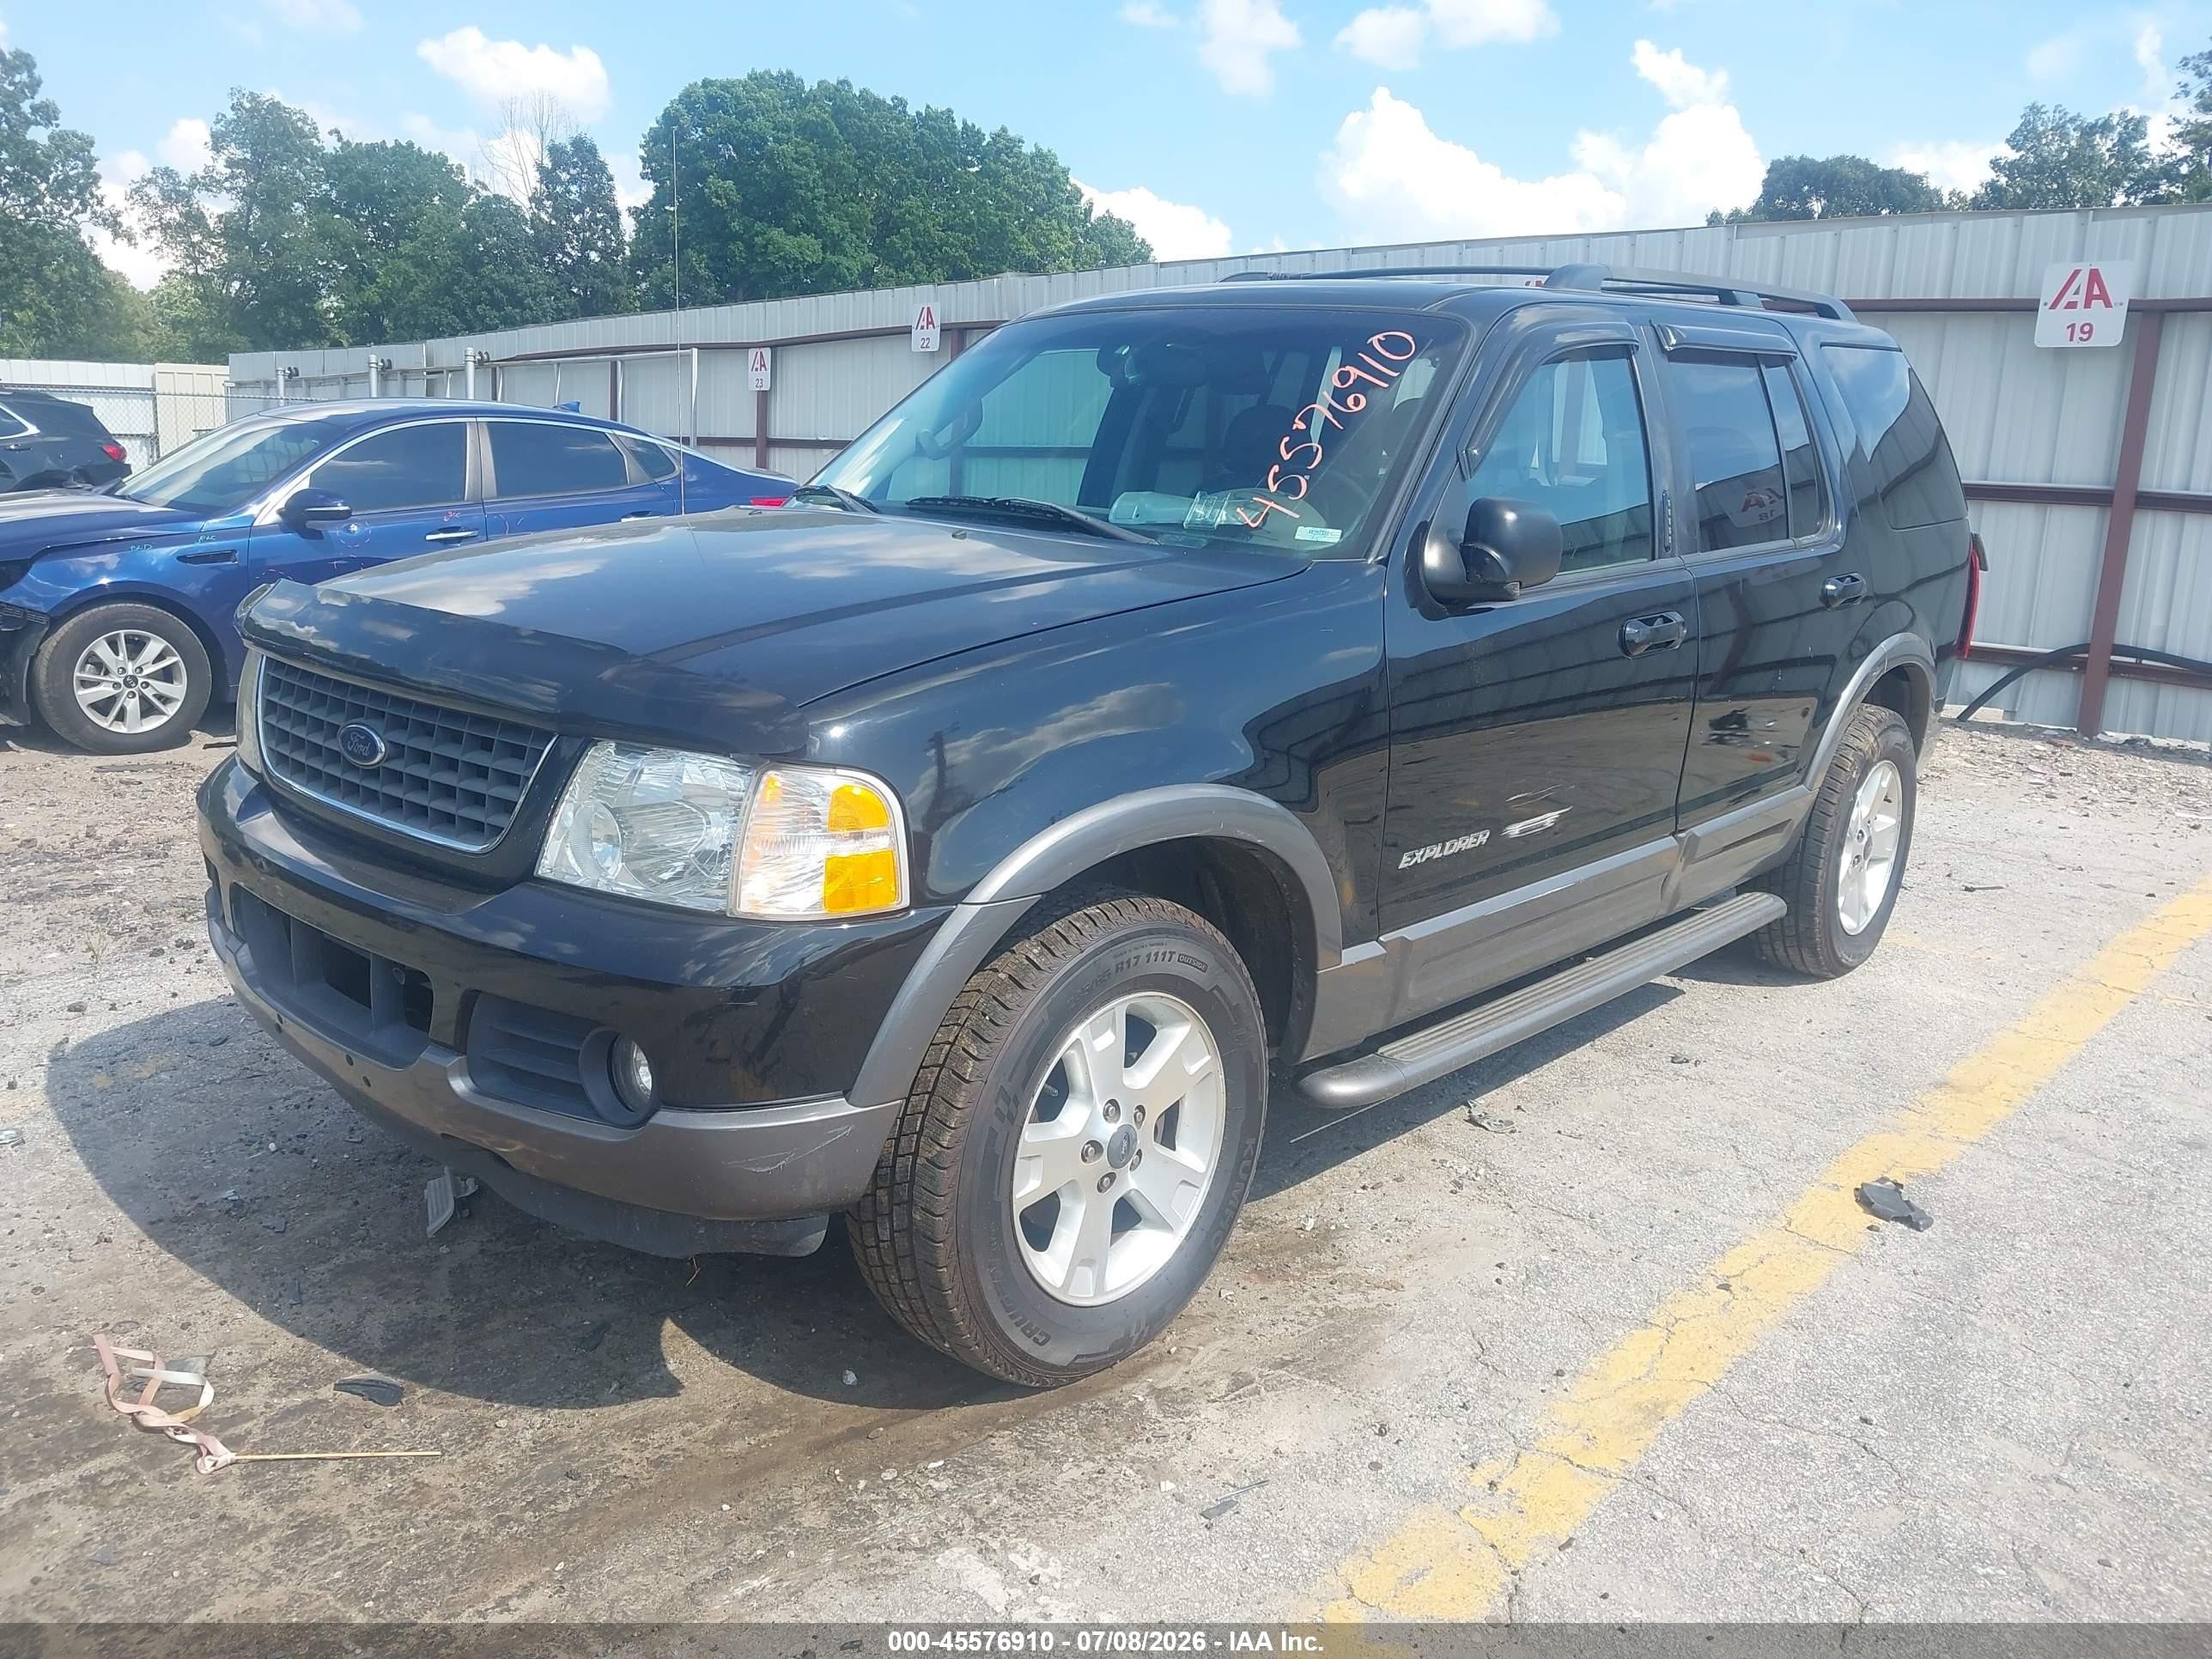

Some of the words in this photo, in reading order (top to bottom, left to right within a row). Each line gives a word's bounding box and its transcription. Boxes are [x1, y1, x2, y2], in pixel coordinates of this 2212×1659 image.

[2066, 322, 2094, 342] 19
[921, 337, 930, 349] 22
[755, 378, 763, 388] 23
[1237, 331, 1416, 528] 45576910
[347, 731, 372, 757] Ford
[1398, 830, 1491, 870] EXPLORER
[1178, 954, 1207, 971] OUTSIDE
